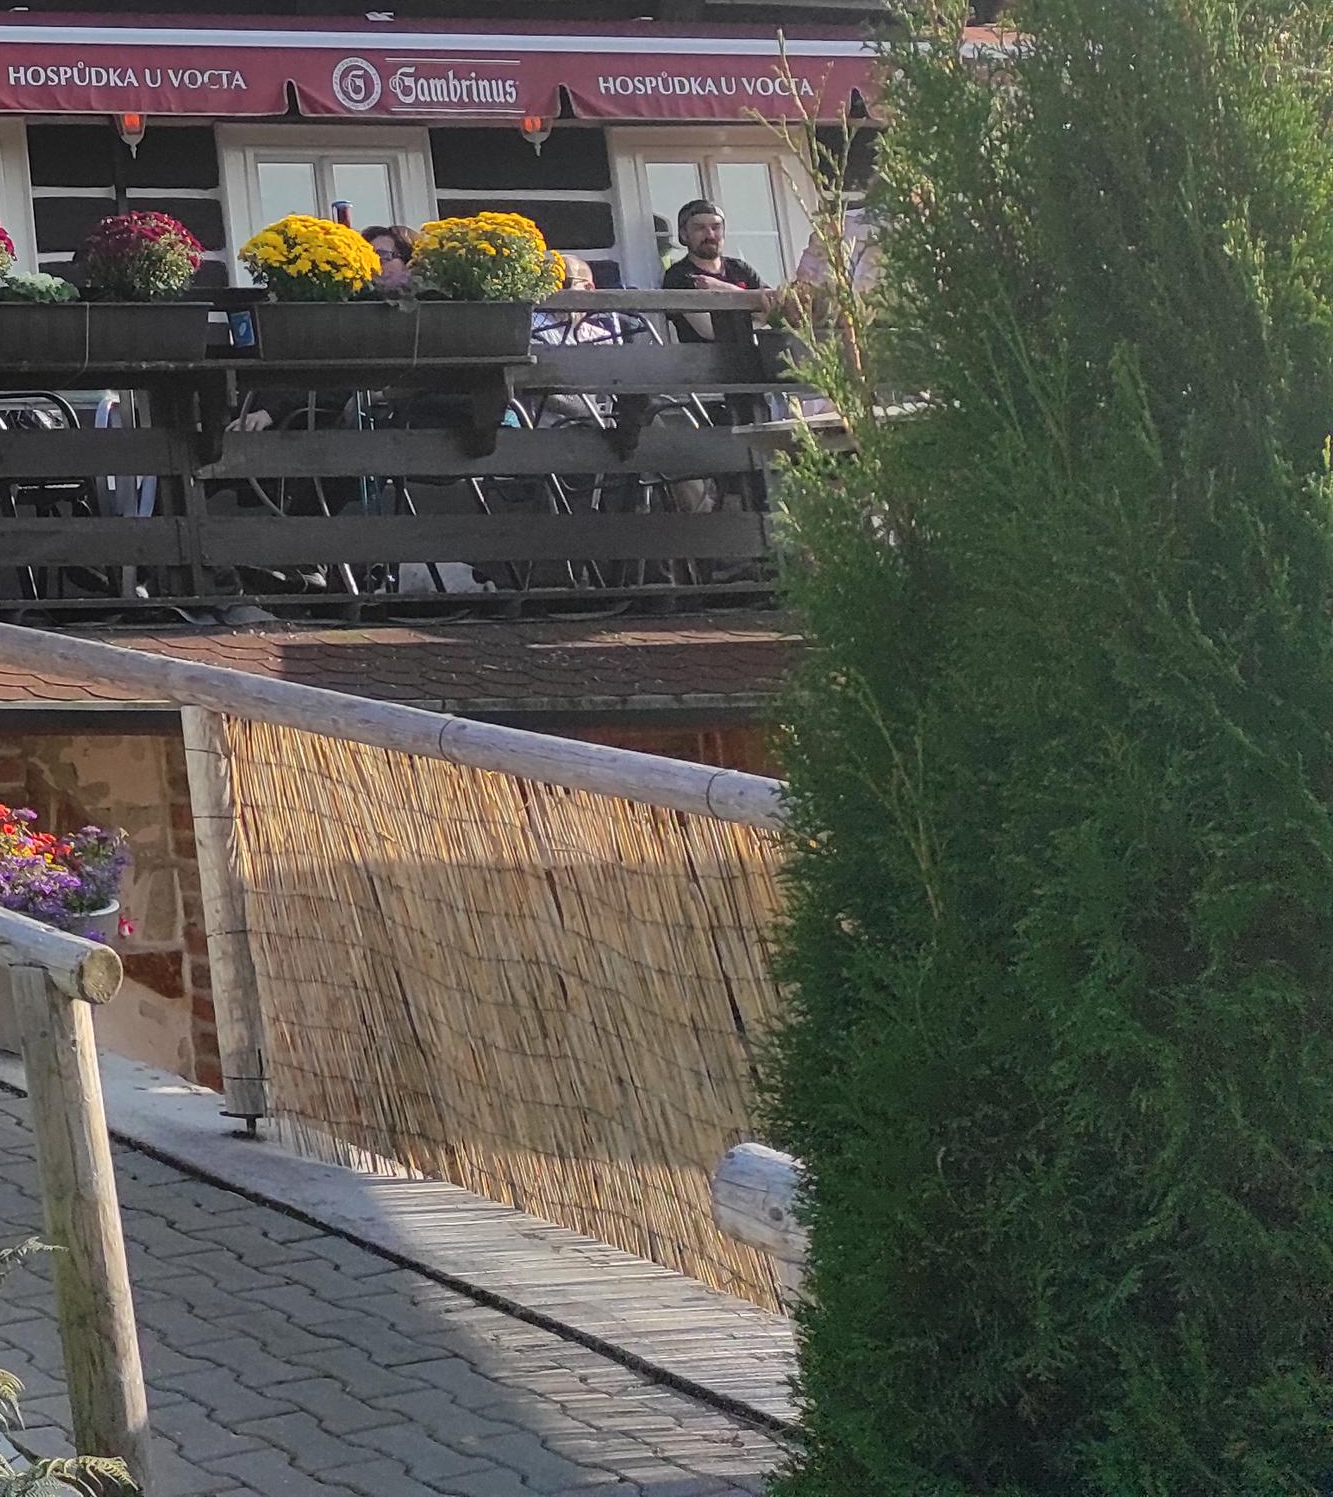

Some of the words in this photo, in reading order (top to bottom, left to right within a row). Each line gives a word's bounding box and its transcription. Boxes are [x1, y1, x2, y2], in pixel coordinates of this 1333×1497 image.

[7, 61, 140, 88] HOSPŮDKA
[144, 69, 162, 88] U
[167, 69, 248, 90] VOCTA
[389, 66, 518, 104] Gambrinus
[598, 70, 719, 96] HOSPŮDKA
[721, 76, 736, 96] U
